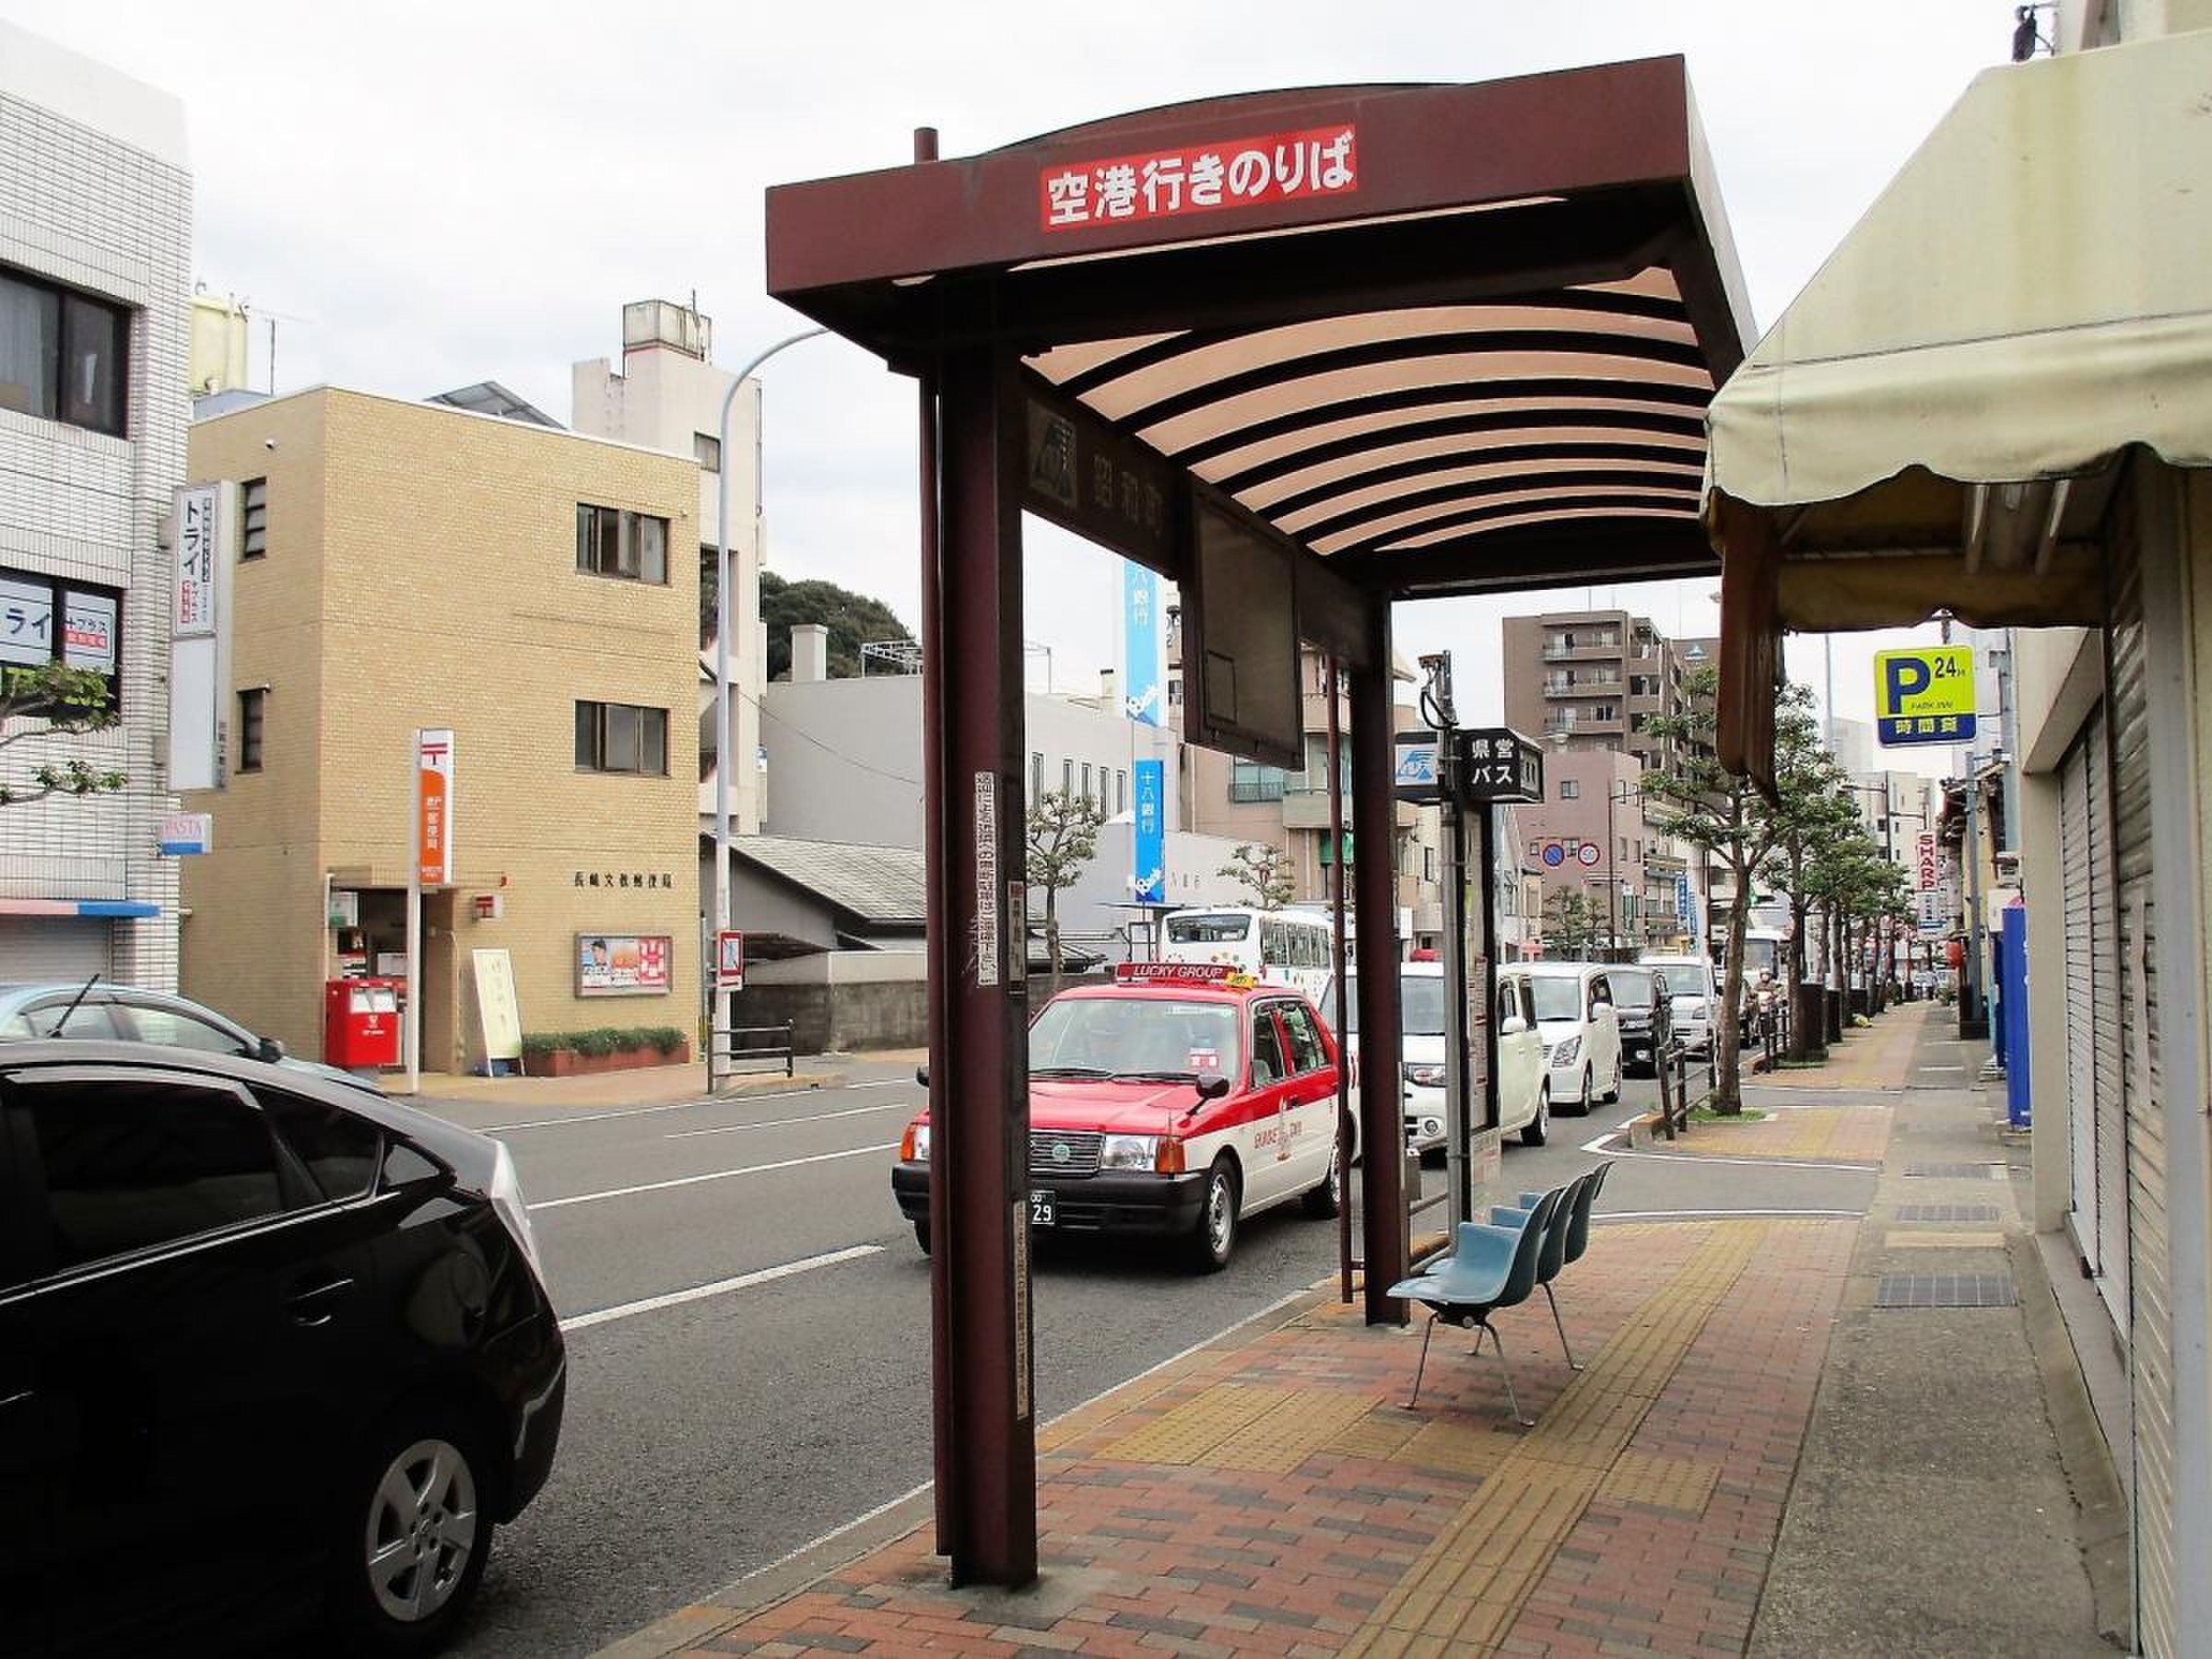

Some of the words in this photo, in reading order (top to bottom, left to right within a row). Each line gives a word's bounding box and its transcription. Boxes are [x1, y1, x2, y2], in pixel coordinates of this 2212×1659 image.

[1047, 130, 1356, 226] 空港行きのりば
[183, 500, 200, 575] トライ
[1886, 657, 1931, 715] P
[1472, 738, 1514, 759] 県営
[1472, 765, 1513, 784] バス
[1918, 833, 1936, 891] SHARP
[1133, 965, 1176, 977] LUCKY
[1178, 965, 1224, 979] GROUP
[1033, 1204, 1052, 1222] 29
